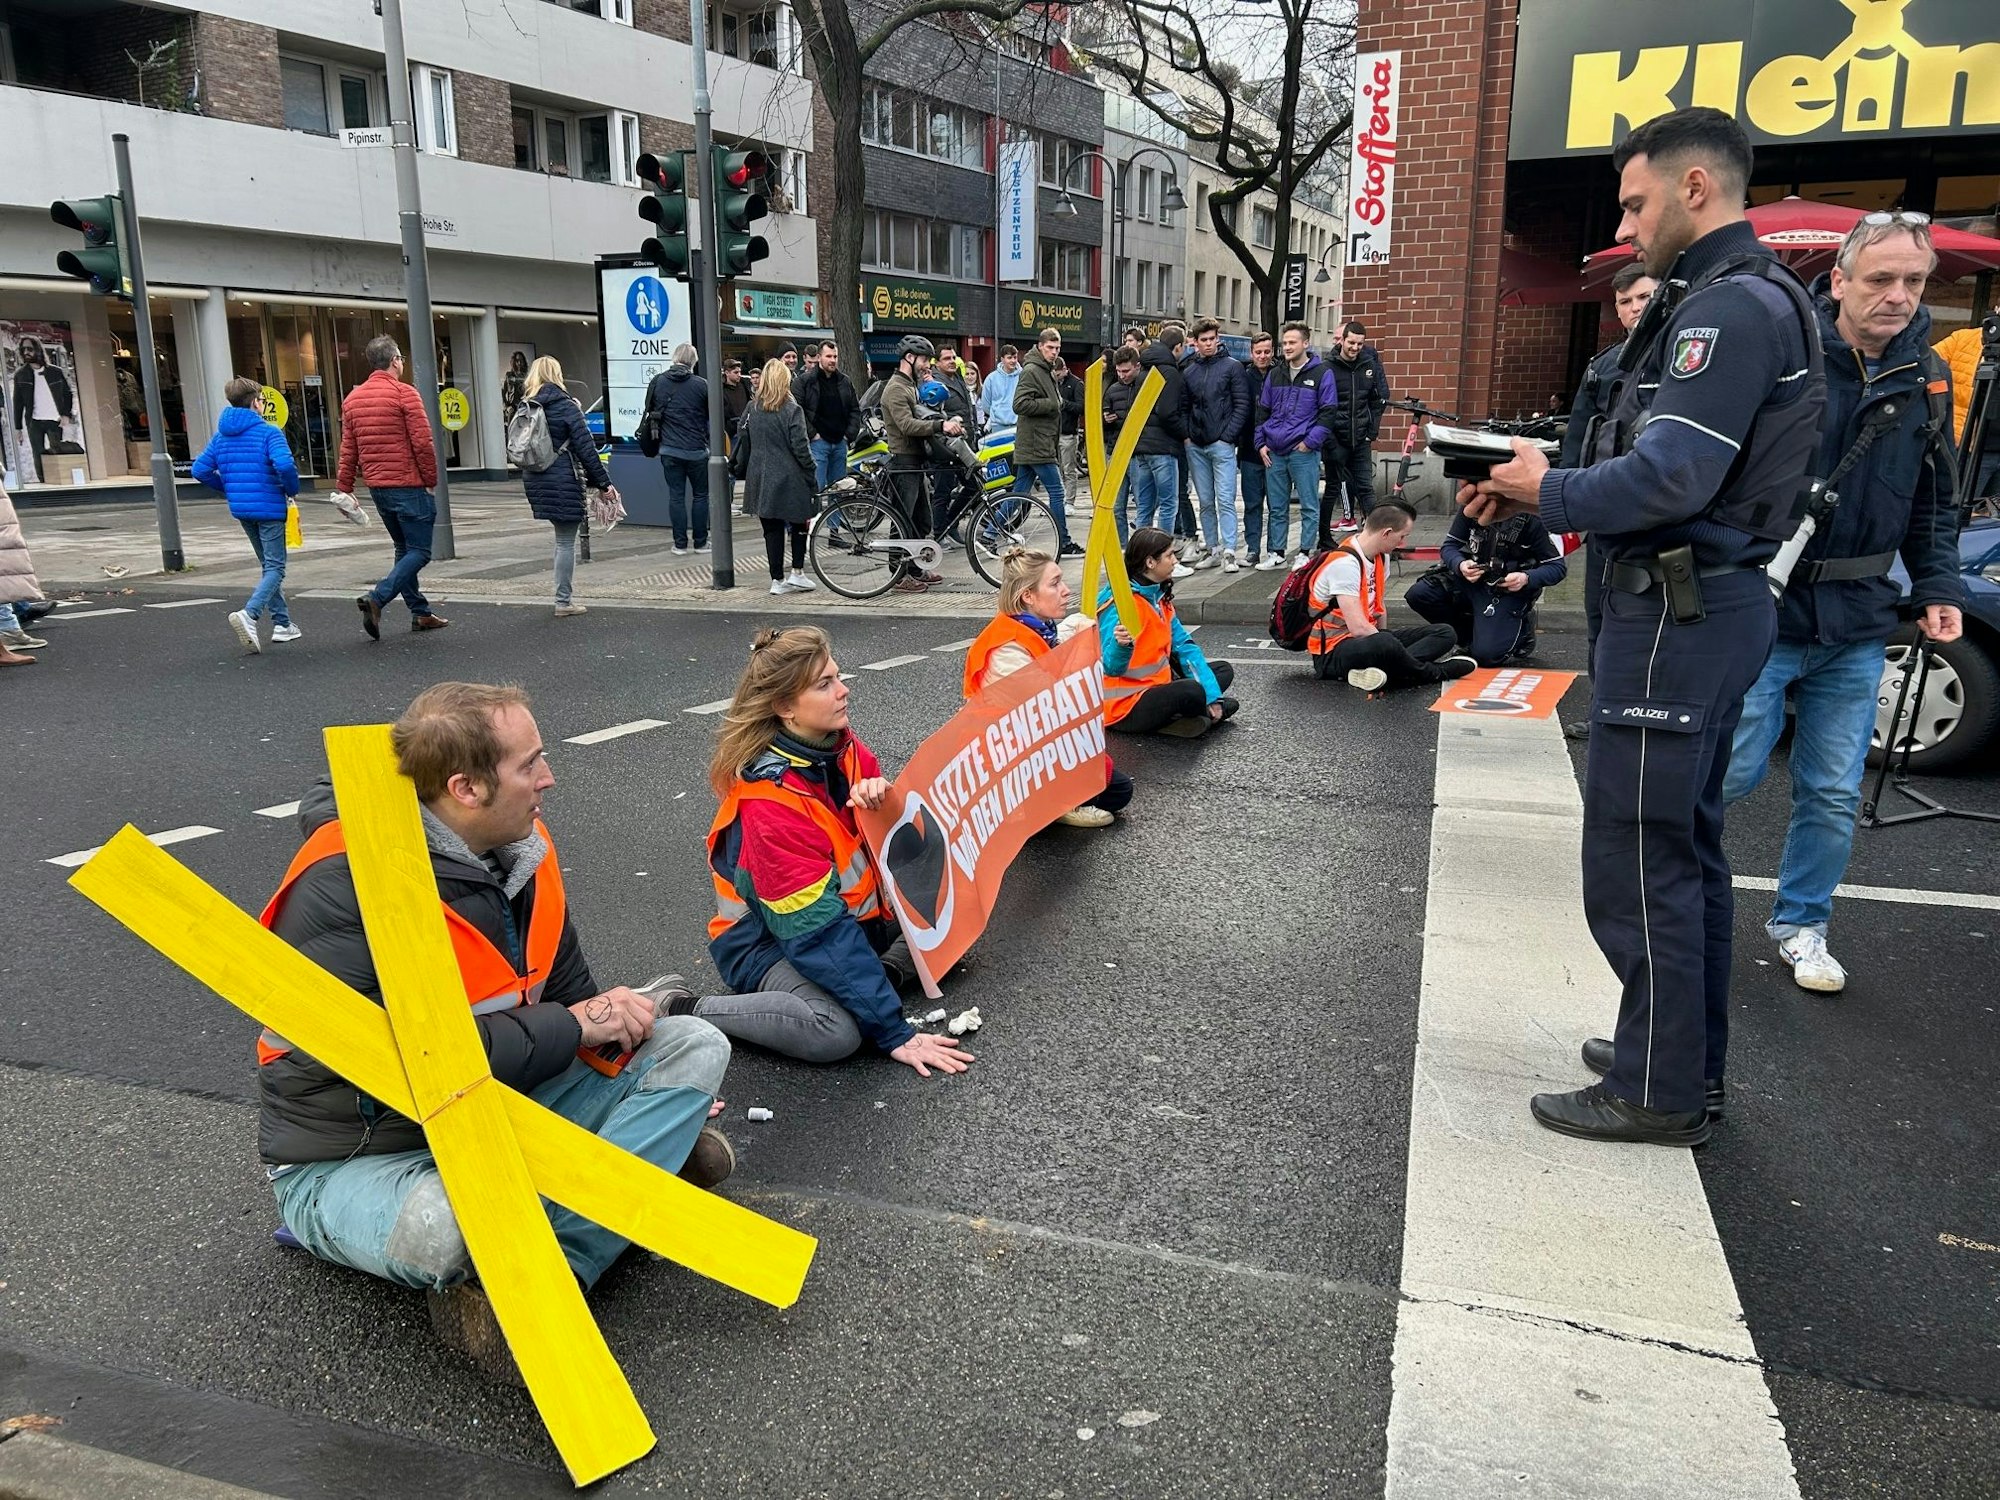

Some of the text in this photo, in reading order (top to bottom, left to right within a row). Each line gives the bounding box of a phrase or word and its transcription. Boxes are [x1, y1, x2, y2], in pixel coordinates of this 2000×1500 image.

[1566, 40, 2000, 150] Klein
[348, 132, 385, 145] Pipinstr.
[1355, 59, 1396, 226] Stofferia
[1012, 161, 1021, 260] TESTZENTRUM
[422, 218, 456, 232] Hohe Str.
[894, 287, 908, 298] stille
[1289, 263, 1302, 311] TIVOLI
[763, 295, 795, 307] HIGH STREET
[767, 307, 792, 318] ESPRESSO
[894, 302, 955, 321] spieldurst
[1679, 329, 1714, 339] POLIZEI
[631, 340, 669, 355] ZONE
[445, 402, 460, 413] 1/2
[1622, 707, 1669, 720] POLIZEI
[928, 736, 990, 834] LETZTE
[970, 784, 1004, 848] DEN
